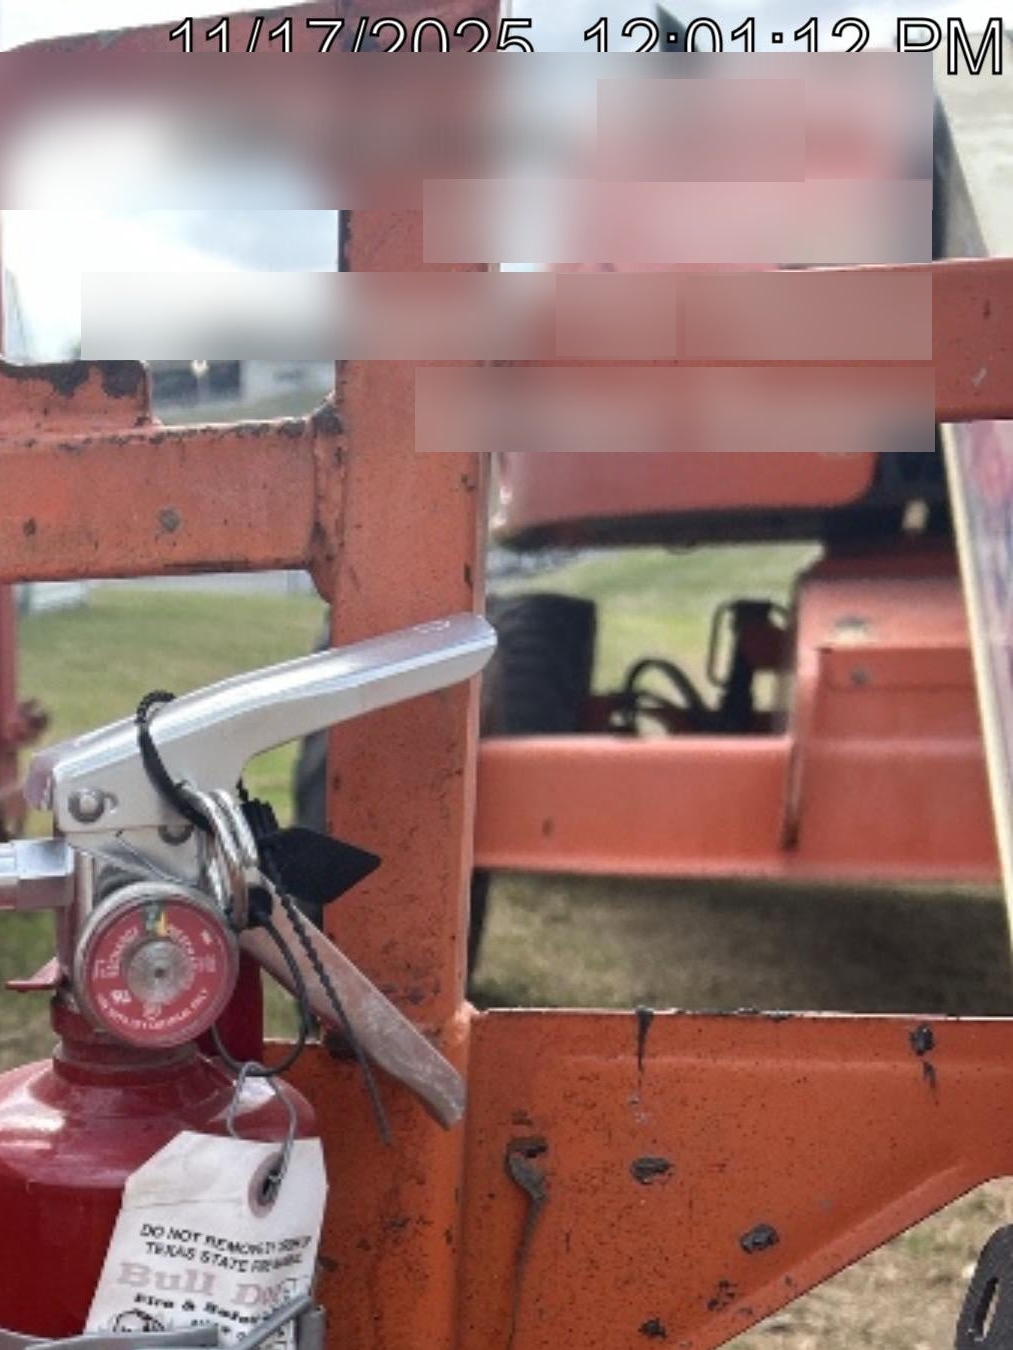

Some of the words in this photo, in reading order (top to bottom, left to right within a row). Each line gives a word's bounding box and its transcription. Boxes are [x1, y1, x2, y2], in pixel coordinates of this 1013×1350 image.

[140, 1223, 165, 1238] DO
[167, 1226, 201, 1242] NOT
[145, 1241, 195, 1261] TEXAS
[200, 1250, 248, 1273] STATE
[117, 1260, 217, 1296] Bull
